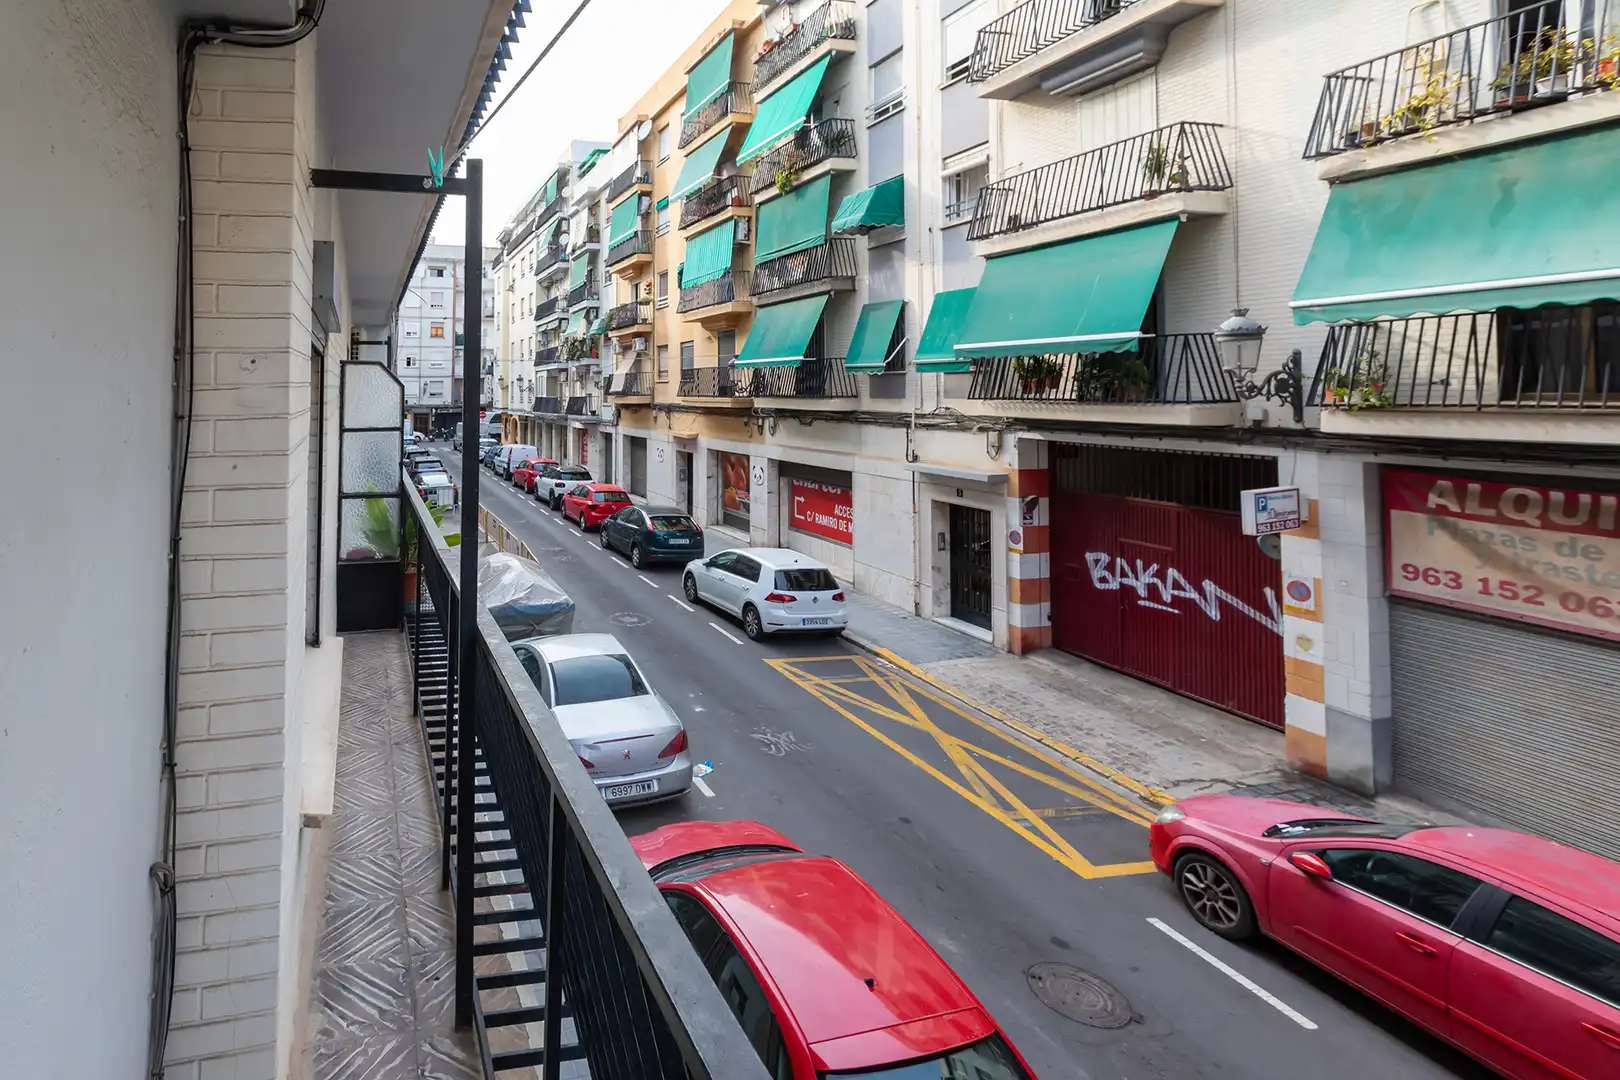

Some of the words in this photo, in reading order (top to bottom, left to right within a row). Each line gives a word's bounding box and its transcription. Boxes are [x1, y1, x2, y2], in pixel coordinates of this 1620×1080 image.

[1427, 480, 1617, 530] ALQUI
[806, 510, 814, 522] C/
[815, 512, 838, 529] RAMIRO
[839, 519, 848, 532] DE
[1257, 523, 1271, 533] 963
[1272, 521, 1285, 531] 152
[1555, 535, 1605, 562] de
[1400, 563, 1463, 590] 963
[1477, 576, 1546, 607] 152
[1558, 591, 1620, 620] 06
[611, 785, 633, 797] 6997
